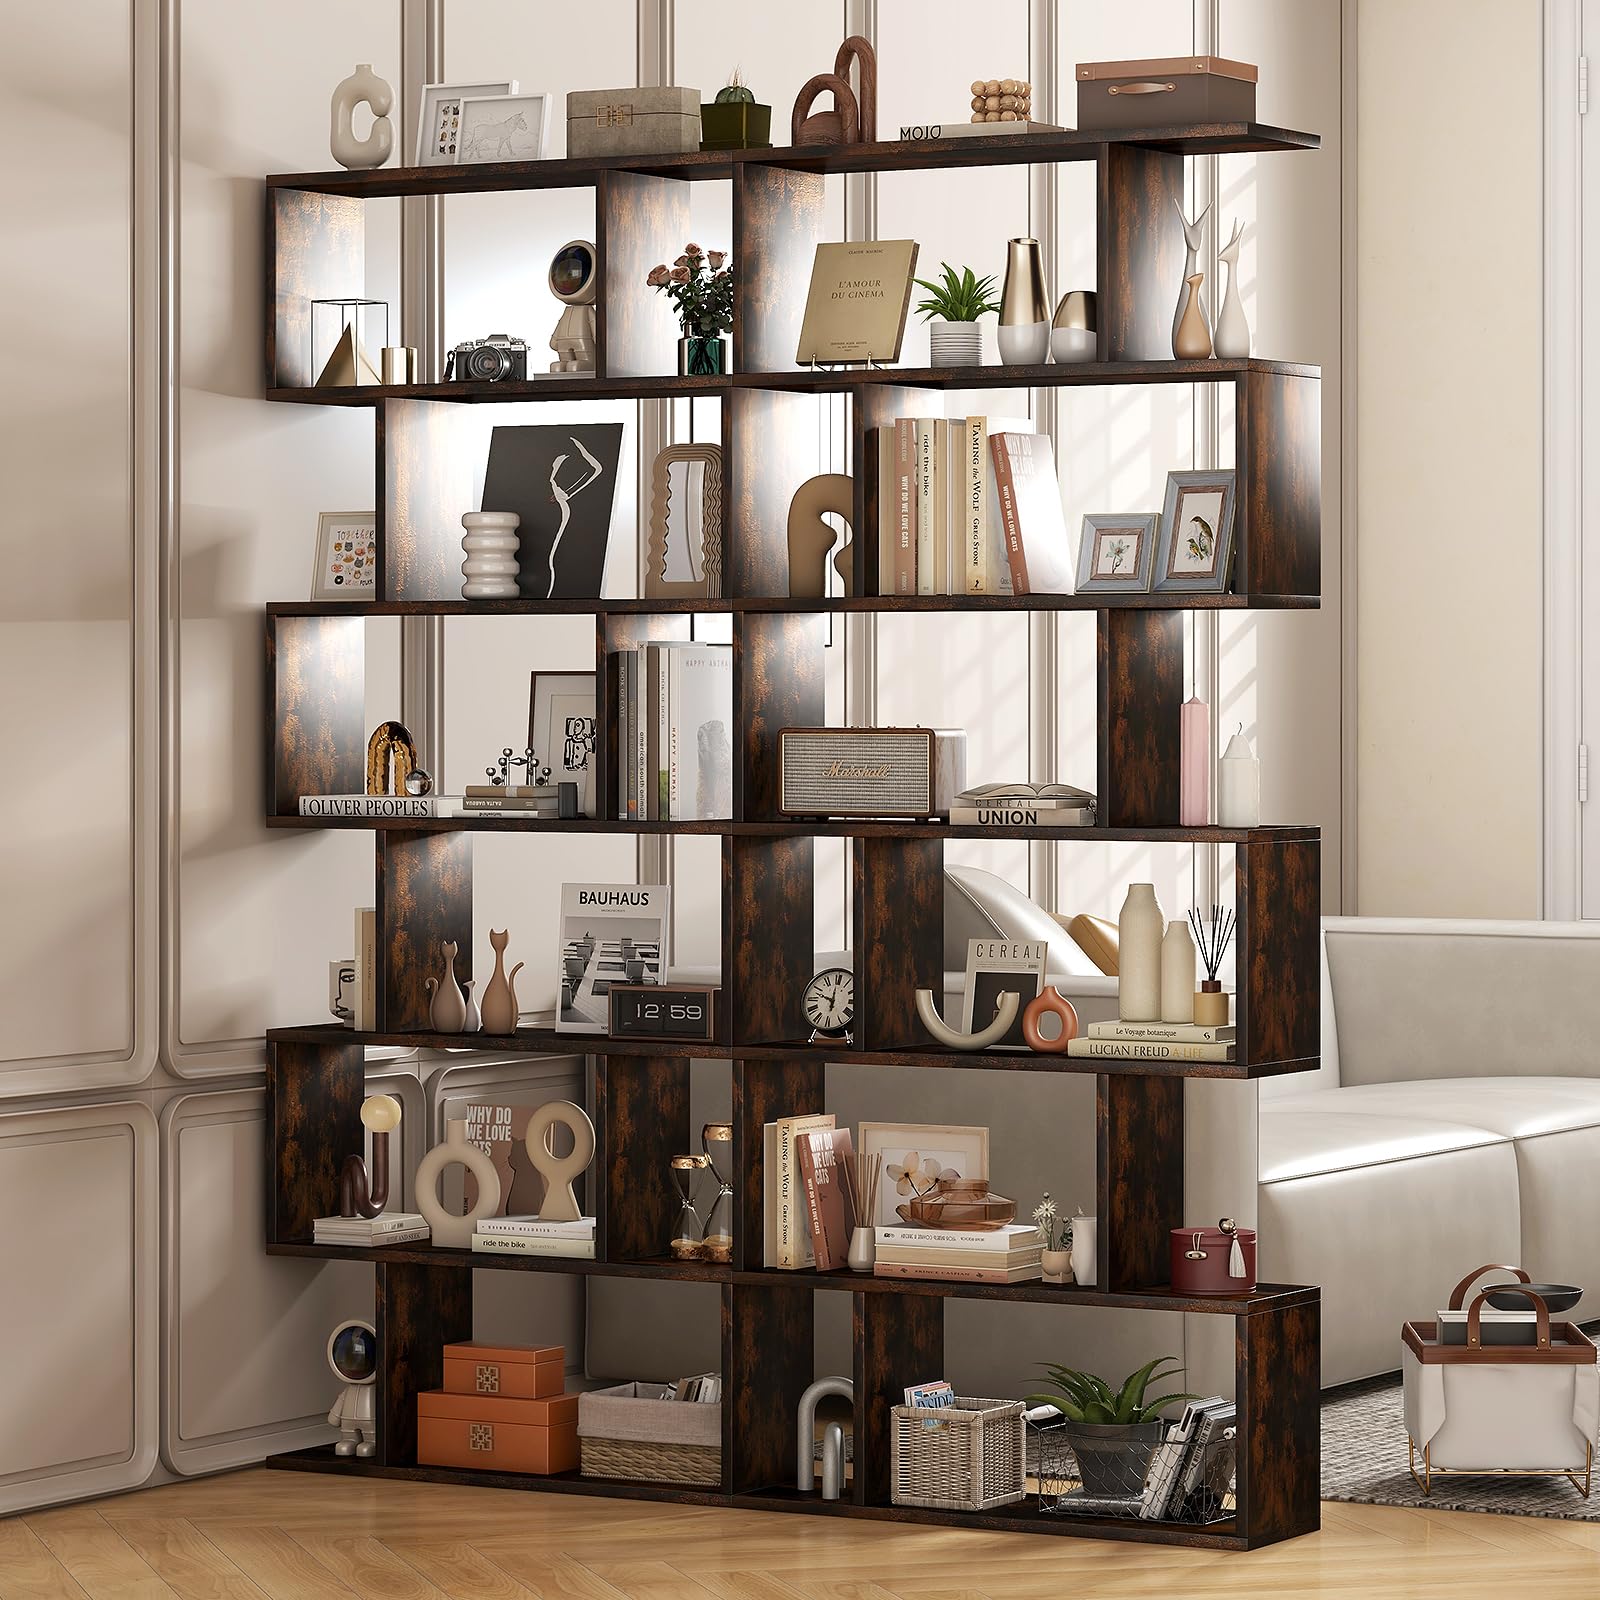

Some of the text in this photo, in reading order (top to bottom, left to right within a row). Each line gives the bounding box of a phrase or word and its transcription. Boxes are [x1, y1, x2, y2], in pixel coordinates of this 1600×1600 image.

[838, 279, 881, 288] L'AMOUR
[972, 422, 981, 465] TAMING
[972, 481, 981, 512] WOLF
[1005, 499, 1011, 510] DO
[901, 475, 909, 548] WHY DO WE LOVE CATS
[1007, 509, 1013, 520] WE
[821, 760, 892, 778] Marshall
[309, 799, 362, 815] OLIVER
[365, 800, 428, 816] PEOPLES
[975, 800, 1033, 808] CEREAL
[978, 810, 1037, 825] UNION
[579, 891, 649, 906] BAUHAUS
[976, 943, 1040, 959] CEREAL
[1124, 1028, 1146, 1038] Voyage
[1147, 1028, 1177, 1037] botanique
[1089, 1044, 1130, 1056] LUCIAN
[1134, 1046, 1170, 1057] FREUD
[466, 1106, 512, 1125] WHY DO
[467, 1124, 512, 1141] WE LOVE
[782, 1124, 790, 1161] TAMING
[812, 1151, 822, 1168] WE
[781, 1173, 790, 1200] WOLF
[809, 1190, 815, 1199] DO
[811, 1198, 817, 1207] WE
